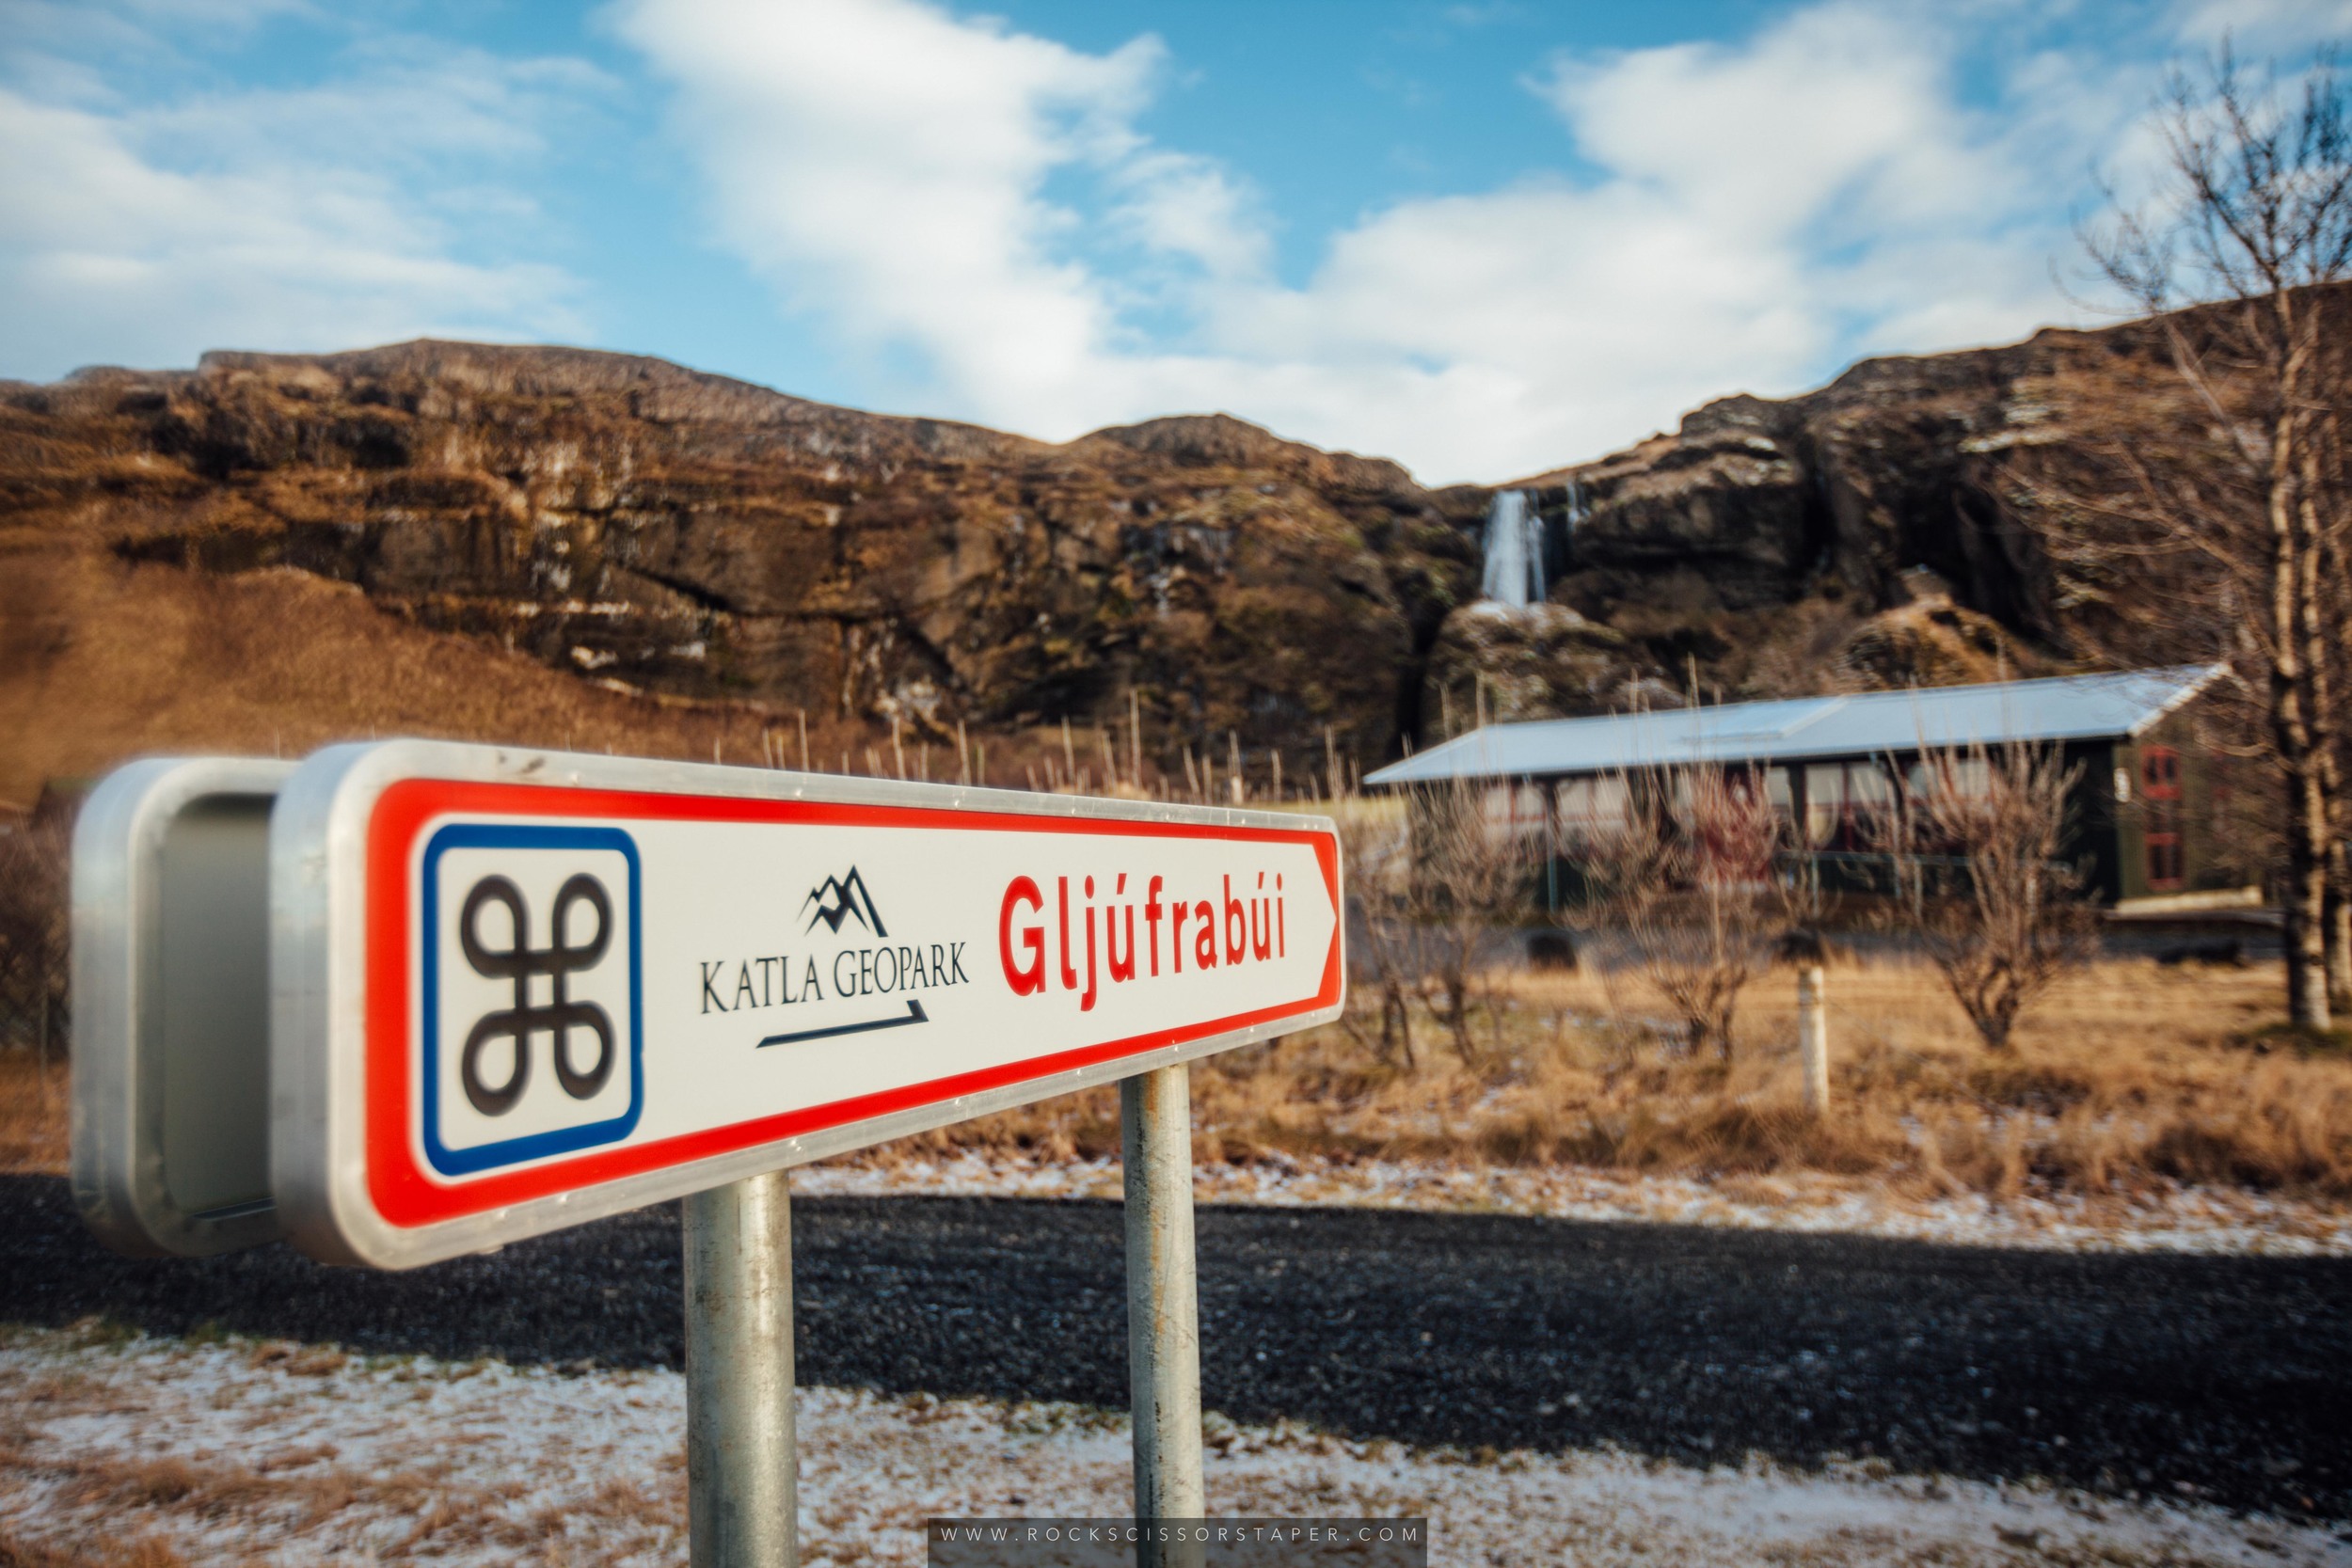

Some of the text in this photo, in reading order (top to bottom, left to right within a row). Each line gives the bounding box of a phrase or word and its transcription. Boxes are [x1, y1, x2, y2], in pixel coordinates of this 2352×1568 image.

[700, 941, 970, 1014] KATLA GEOPARK
[998, 872, 1286, 1011] Gljúfrabúi
